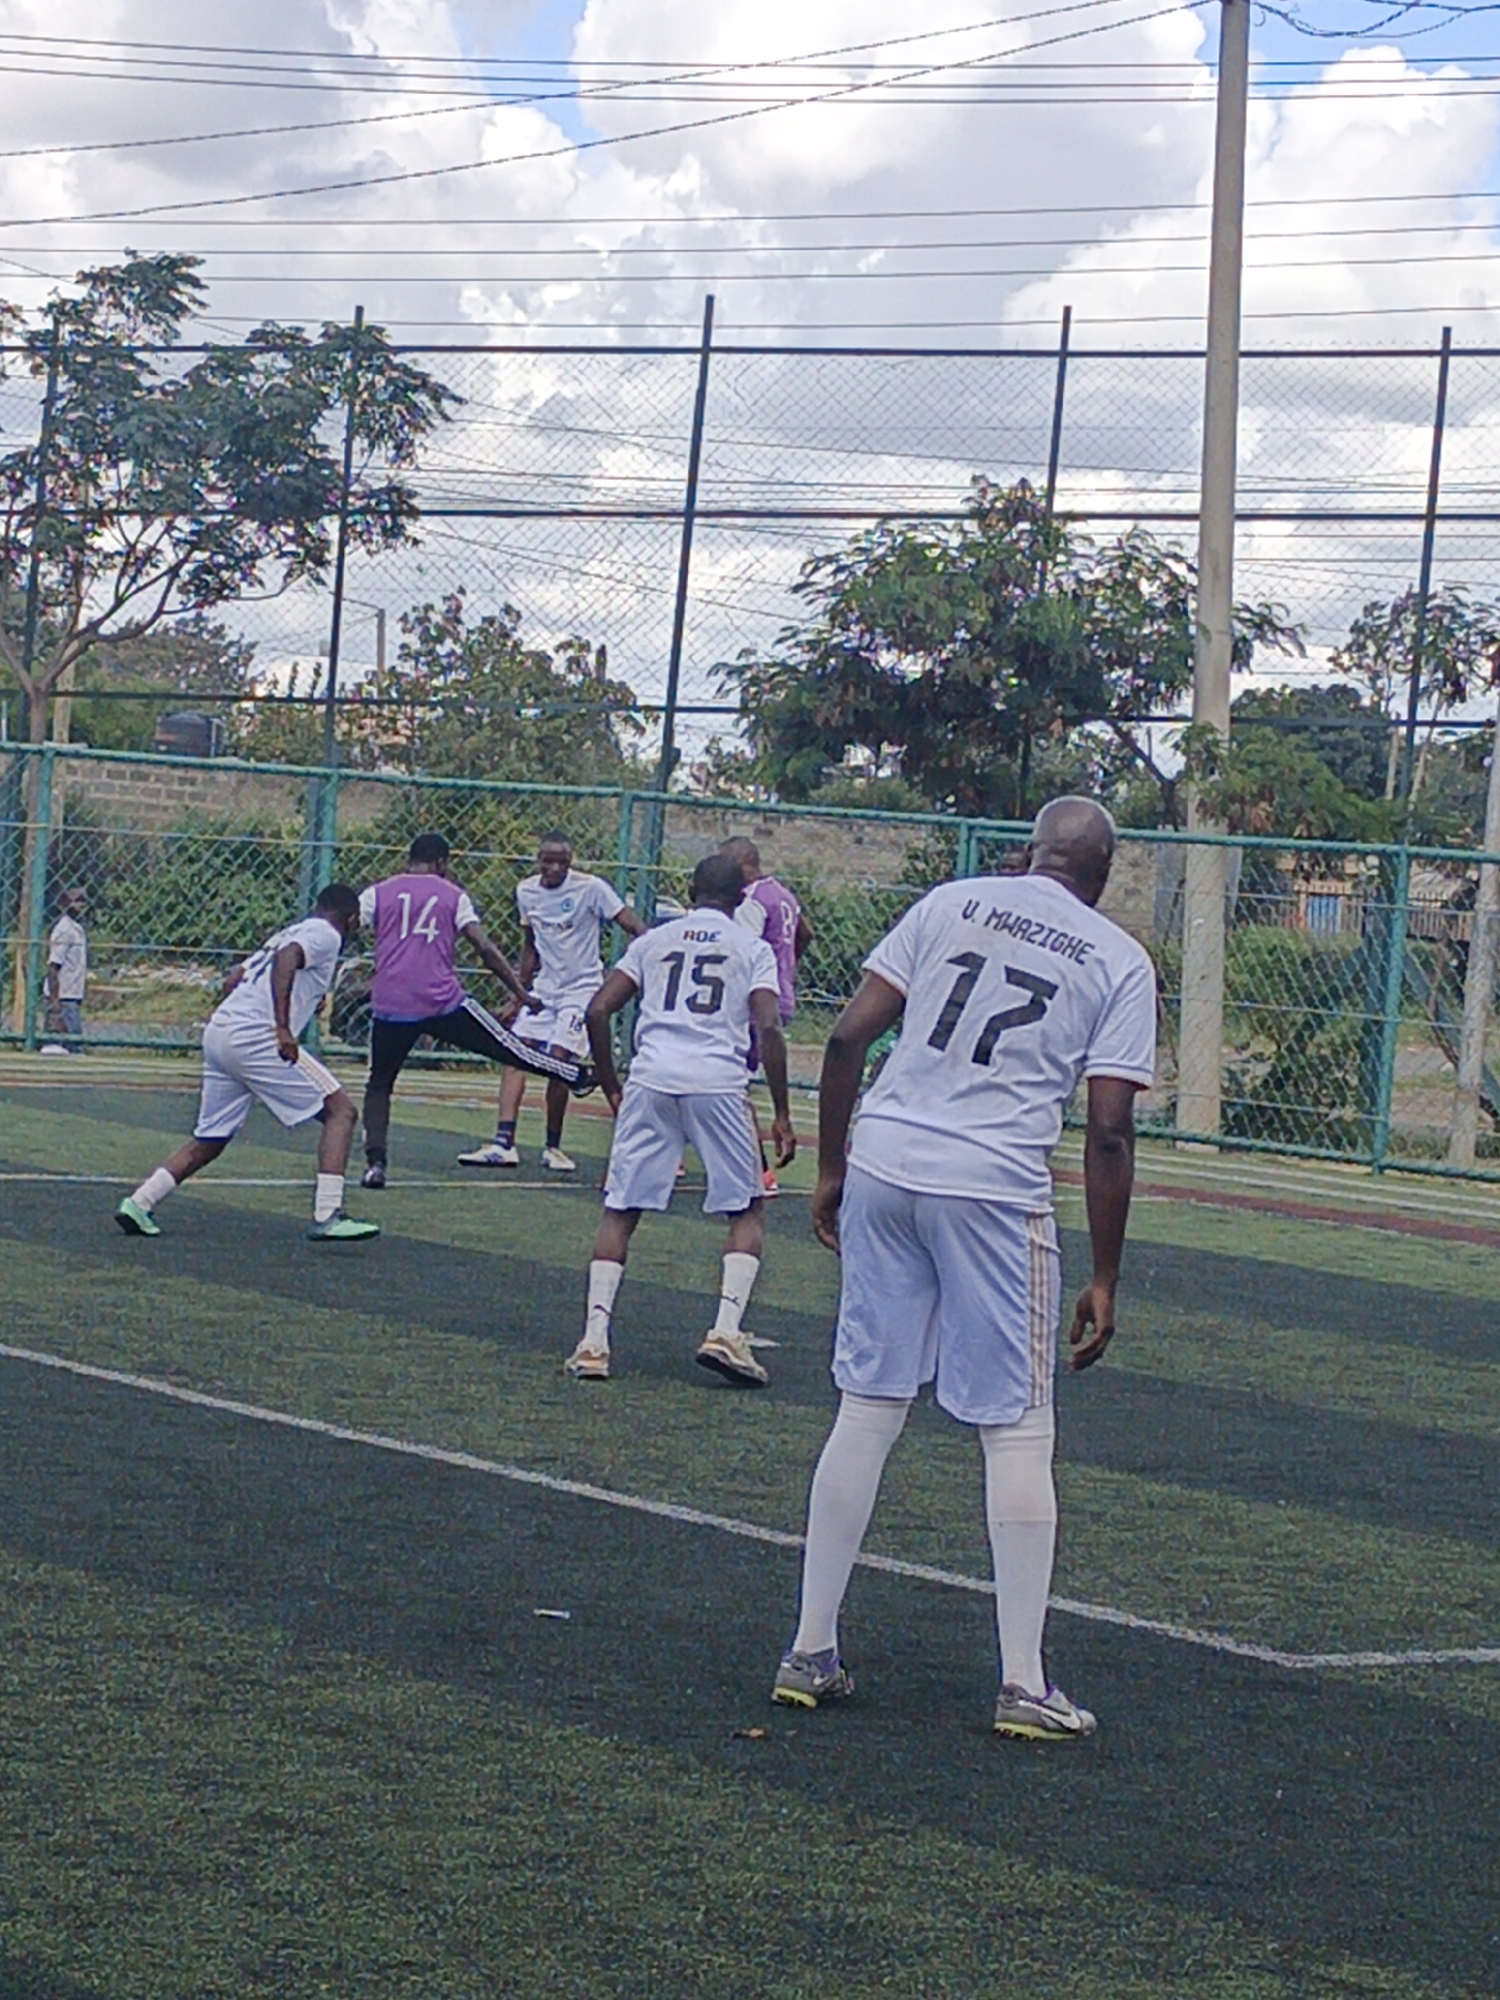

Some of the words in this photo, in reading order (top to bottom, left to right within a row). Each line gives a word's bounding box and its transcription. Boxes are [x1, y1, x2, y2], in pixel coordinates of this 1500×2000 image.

[397, 892, 439, 943] 14
[984, 907, 1096, 966] MWAZIGHE
[661, 951, 729, 1015] 15
[927, 951, 1060, 1067] 17
